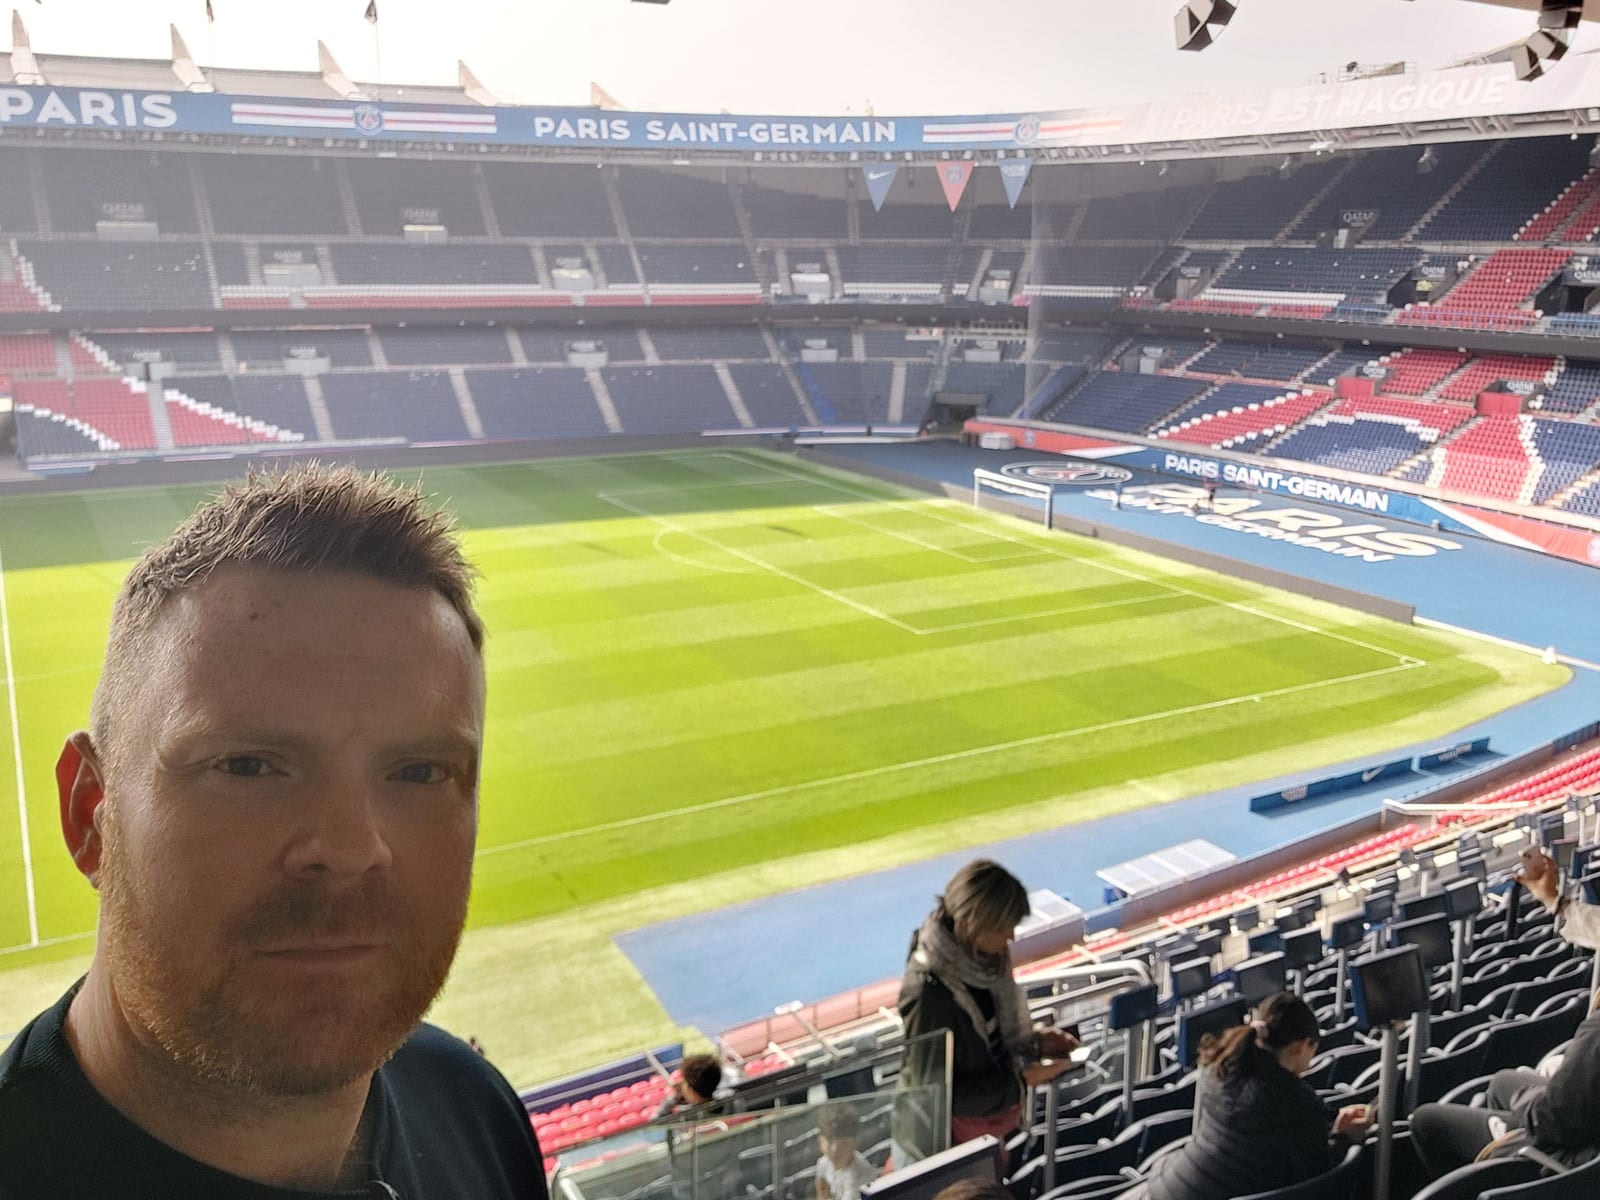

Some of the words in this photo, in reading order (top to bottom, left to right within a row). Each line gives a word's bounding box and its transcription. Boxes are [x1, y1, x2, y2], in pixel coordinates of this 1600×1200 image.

[0, 88, 178, 128] PARIS
[1172, 103, 1262, 130] PARIS
[1268, 94, 1336, 123] EST
[1334, 75, 1511, 118] MAGIQUE
[534, 117, 631, 141] PARIS
[646, 120, 897, 144] SAINT-GERMAIN
[1165, 455, 1218, 478] PARIS
[1223, 464, 1389, 512] SAINT-GERMAIN
